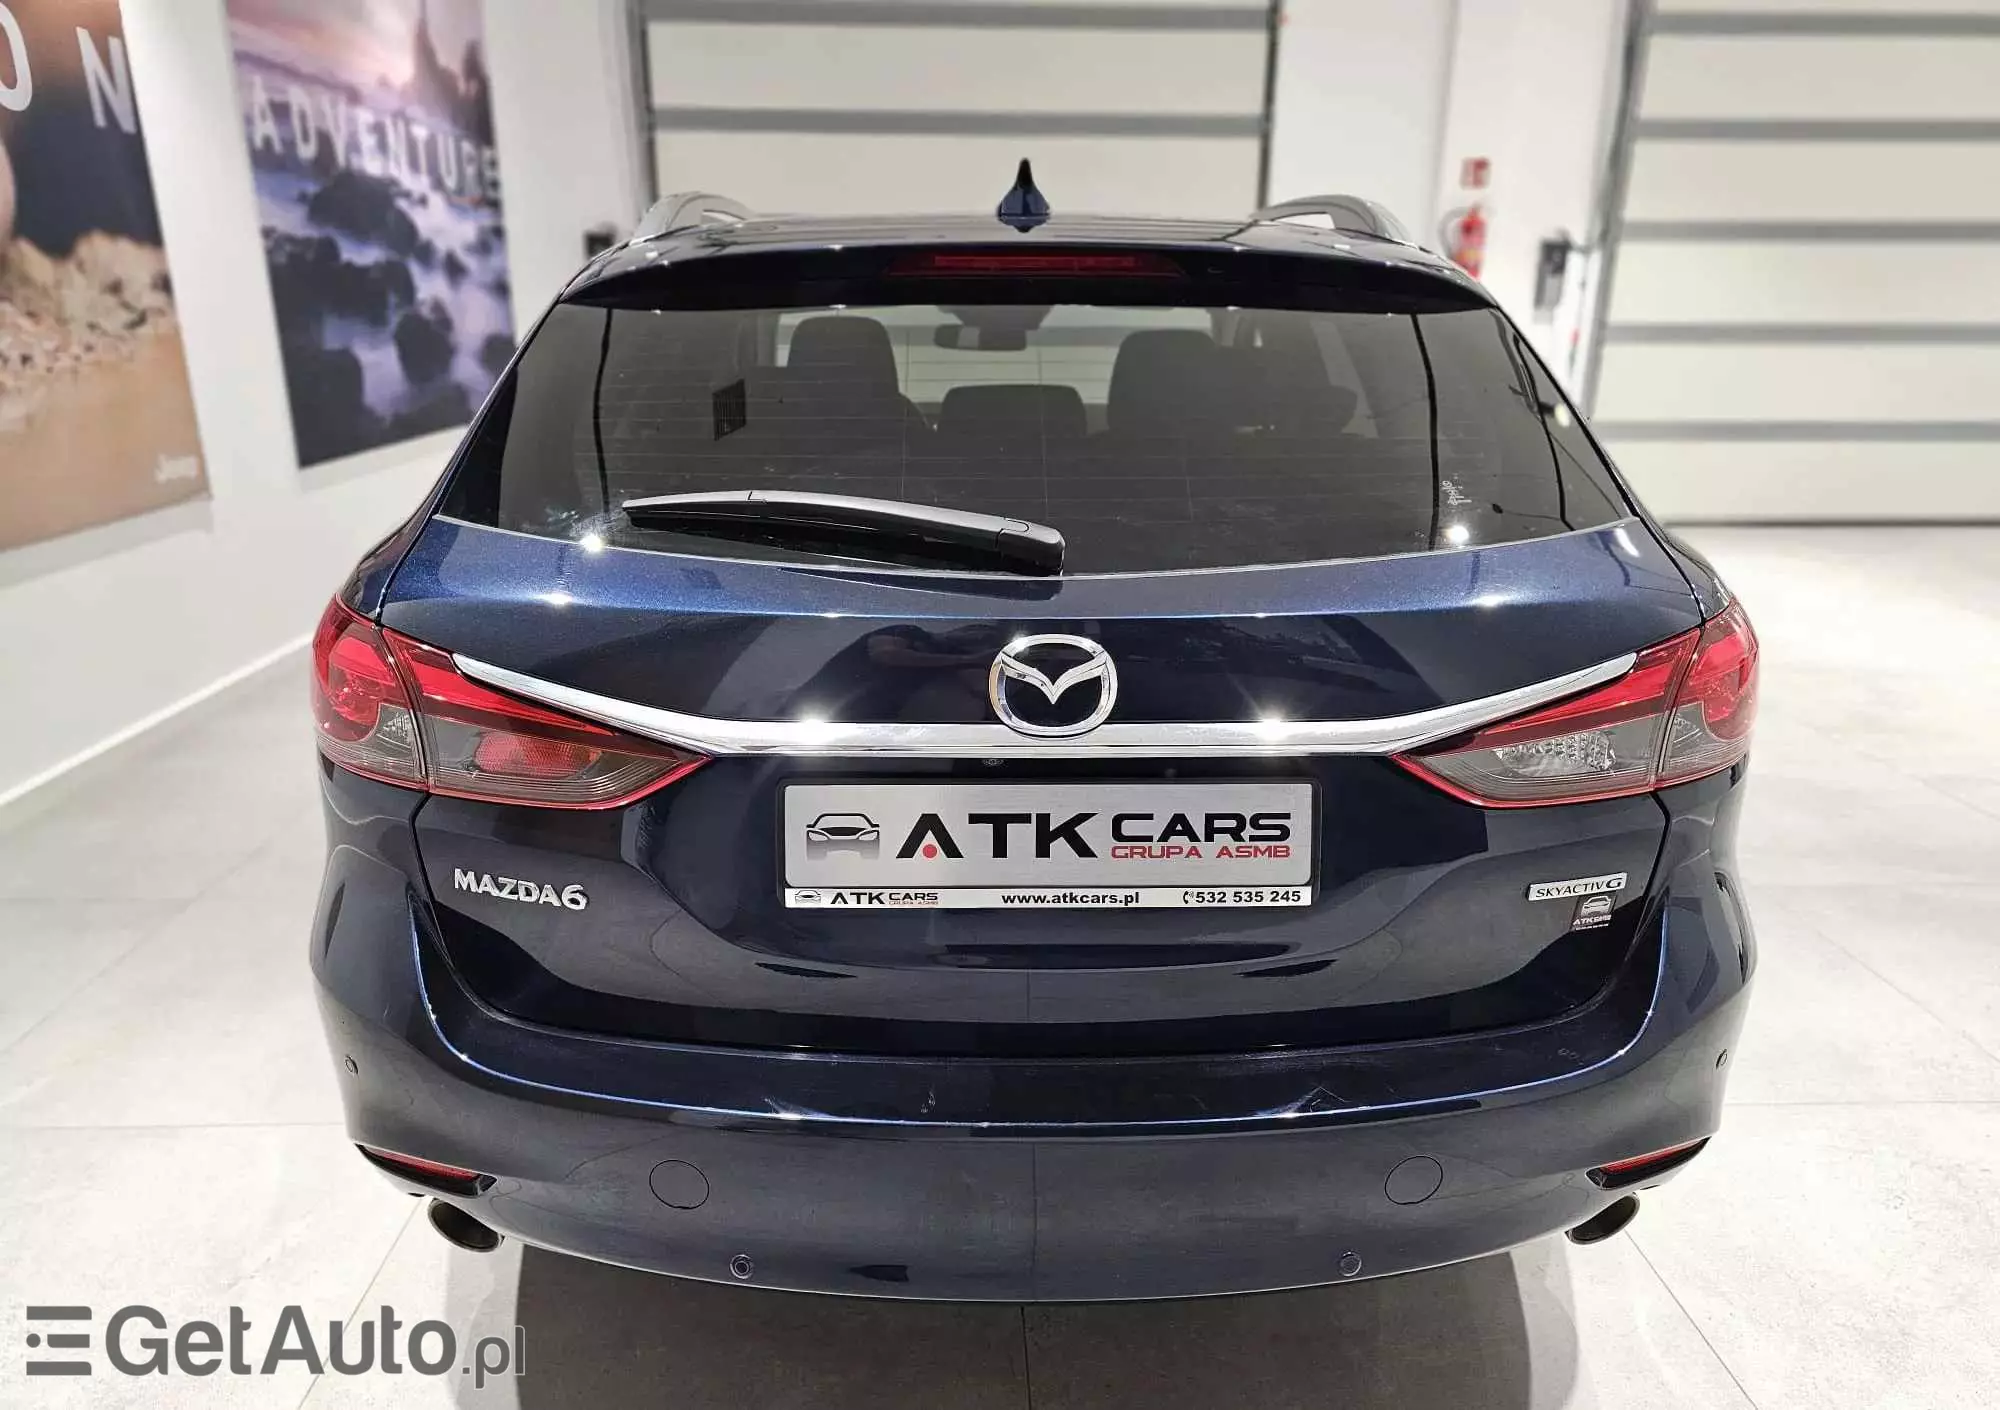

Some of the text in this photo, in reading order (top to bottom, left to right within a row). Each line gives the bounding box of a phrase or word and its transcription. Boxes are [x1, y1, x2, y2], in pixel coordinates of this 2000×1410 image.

[252, 75, 500, 198] ADVENTURE
[896, 813, 1291, 858] ATK CARS
[1111, 845, 1290, 858] GRUPA ASMB
[830, 892, 885, 905] ATK
[889, 892, 939, 901] CARS
[1001, 892, 1140, 906] www.atkcars.pl
[1195, 890, 1301, 903] 532 535 245
